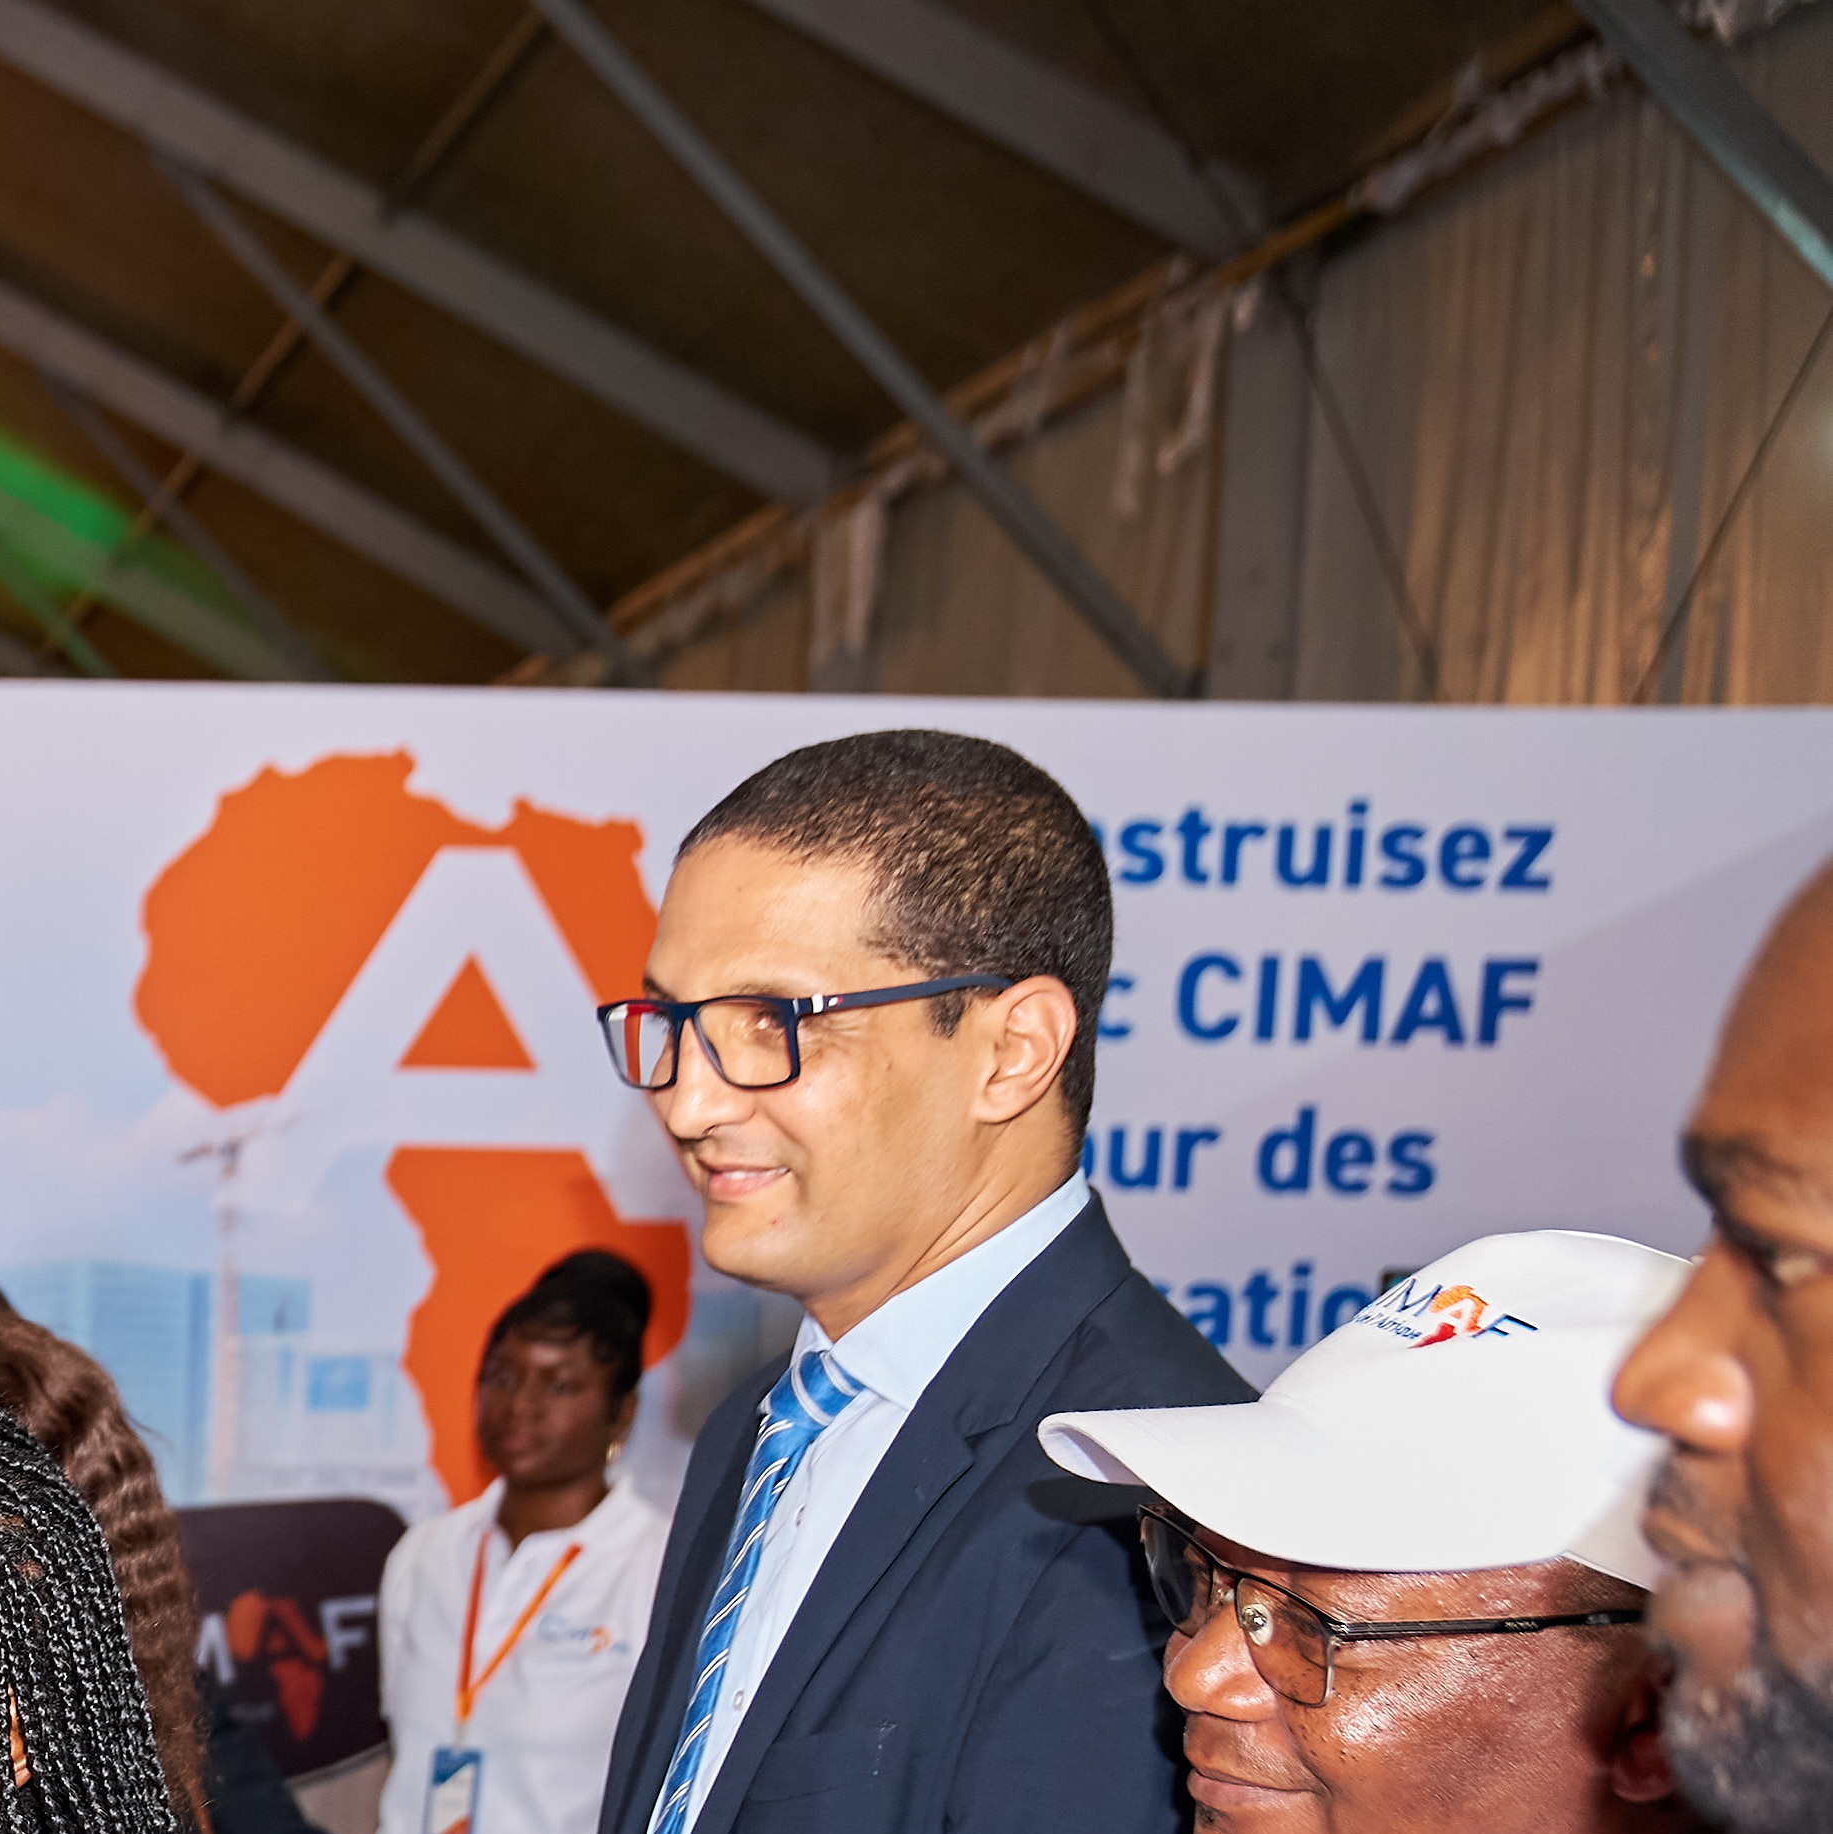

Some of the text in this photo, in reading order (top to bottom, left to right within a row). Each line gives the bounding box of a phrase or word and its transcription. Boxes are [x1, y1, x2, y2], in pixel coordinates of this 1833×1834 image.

[1088, 796, 1555, 892] struisez
[1175, 953, 1540, 1047] CIMAF
[1257, 1102, 1438, 1195] des
